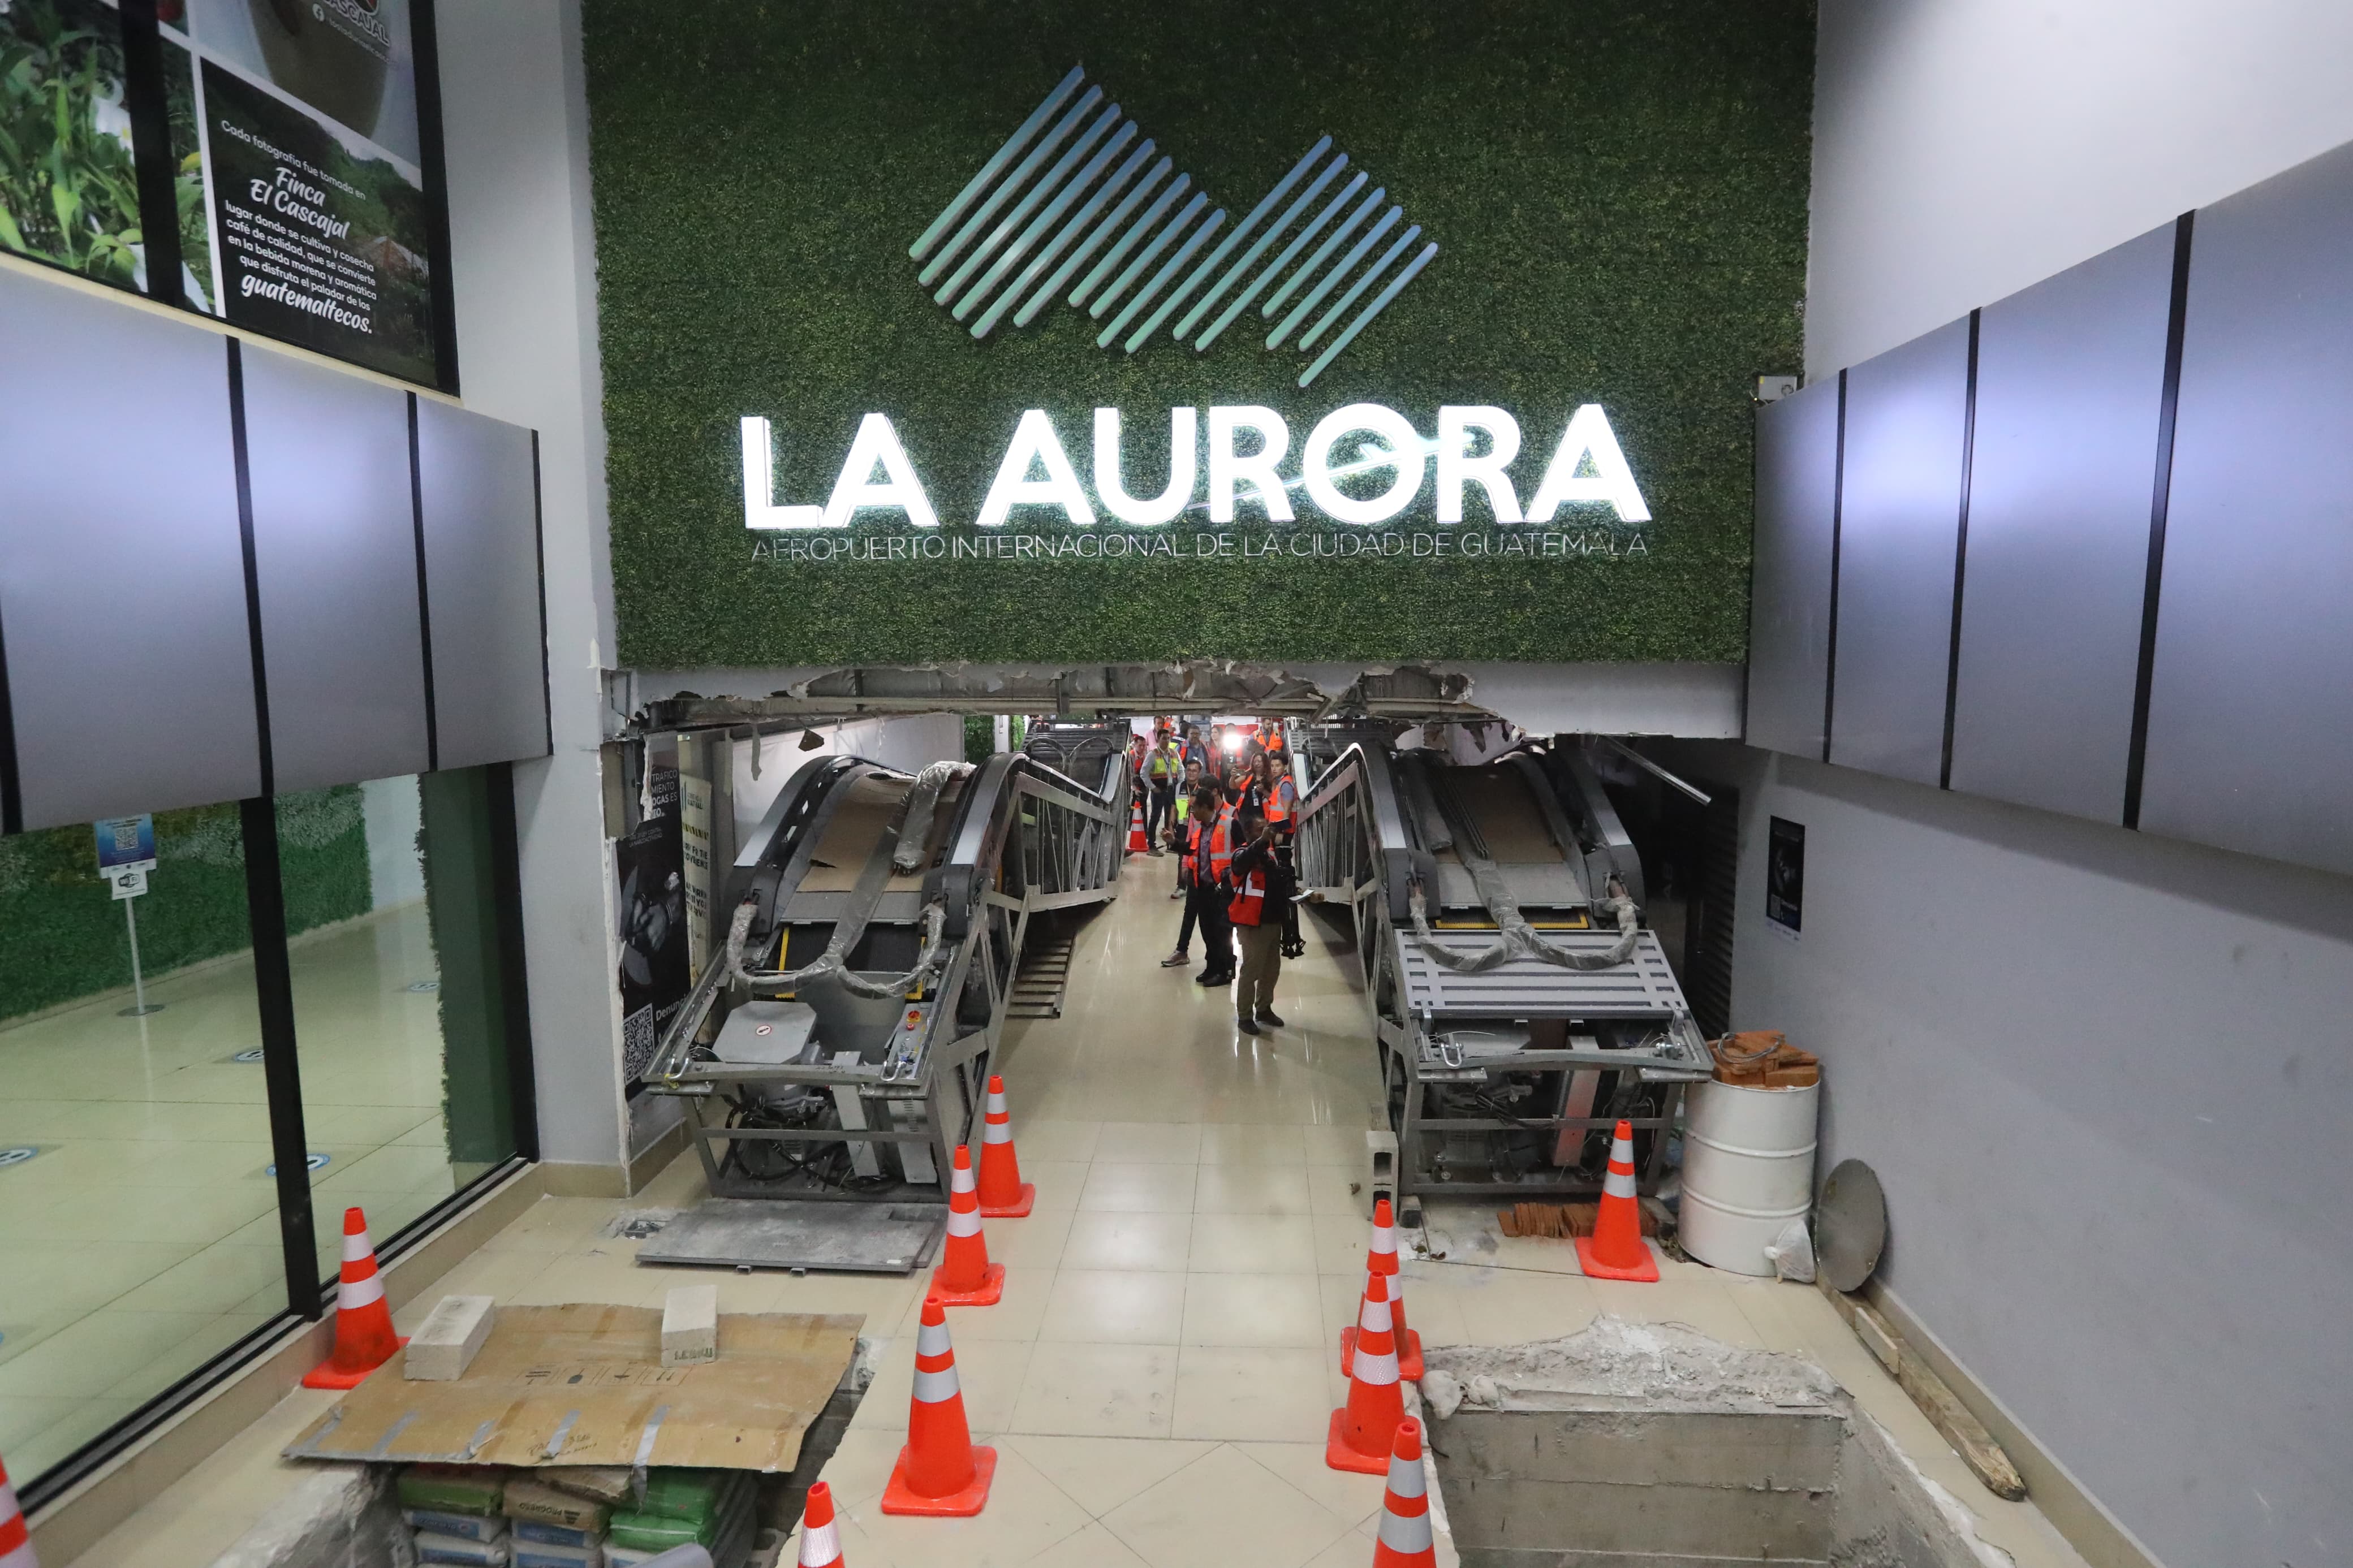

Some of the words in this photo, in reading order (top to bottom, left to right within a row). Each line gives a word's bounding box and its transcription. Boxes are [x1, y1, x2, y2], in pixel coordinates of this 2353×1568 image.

[221, 120, 251, 142] Cada
[303, 161, 318, 177] fue
[319, 170, 354, 195] tomada
[355, 189, 367, 201] en
[275, 167, 326, 207] Finca
[225, 200, 253, 220] lugar
[255, 214, 287, 235] donde
[288, 229, 300, 240] se
[300, 234, 331, 254] cultiva
[333, 248, 339, 259] y
[340, 252, 374, 273] cosecha
[249, 179, 273, 205] El
[274, 190, 351, 240] Cascajal
[226, 218, 251, 235] café
[251, 228, 266, 241] de
[267, 236, 306, 260] calidad,
[307, 253, 325, 266] que
[325, 260, 337, 270] se
[337, 265, 377, 287] convierte
[227, 235, 242, 248] en
[243, 238, 254, 252] la
[255, 244, 290, 266] bebida
[291, 261, 326, 280] morena
[327, 274, 334, 284] y
[334, 277, 377, 301] aromática
[239, 255, 260, 270] que
[261, 263, 300, 284] disfruta
[300, 277, 311, 288] el
[311, 282, 346, 302] paladar
[346, 295, 358, 306] de
[359, 298, 372, 311] los
[241, 274, 373, 334] guatemaltecos.
[741, 412, 941, 529] LA
[975, 403, 1652, 525] AURORA
[751, 534, 947, 560] AEROPUERTO
[953, 533, 1188, 559] INTERNACIONAL
[1197, 533, 1236, 556] DE
[1244, 533, 1282, 557] LA
[1290, 533, 1404, 557] CIUDAD
[1413, 532, 1453, 556] DE
[1460, 532, 1649, 556] GUATEMALA
[670, 792, 678, 802] ES
